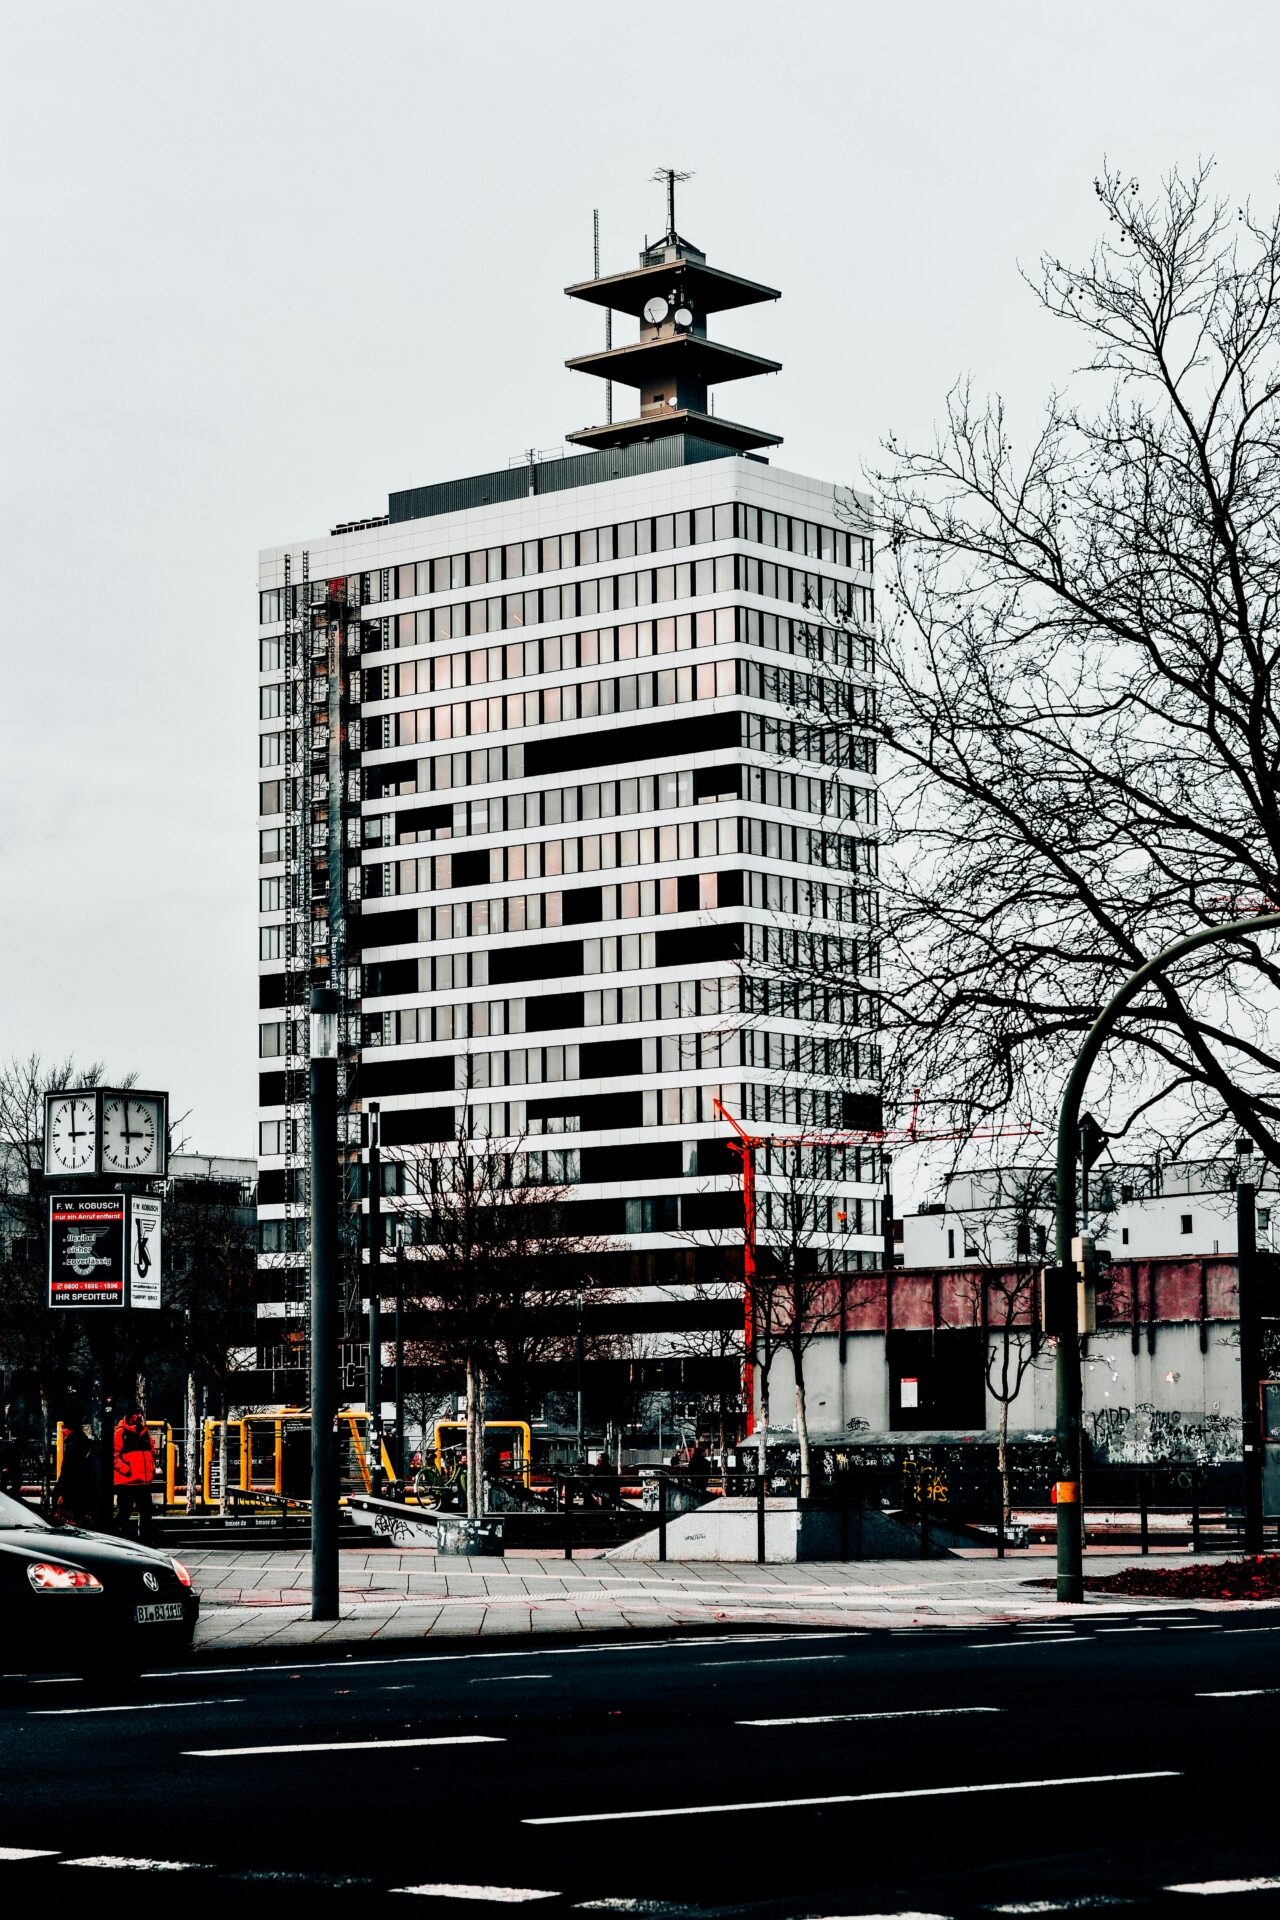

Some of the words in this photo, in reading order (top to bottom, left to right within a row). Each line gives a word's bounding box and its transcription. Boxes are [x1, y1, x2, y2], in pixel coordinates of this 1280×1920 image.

[331, 968, 338, 980] im
[79, 1202, 120, 1210] KOBUSCH
[66, 1233, 97, 1242] flexibel
[66, 1245, 93, 1254] sicher
[55, 1293, 70, 1301] IHR
[71, 1292, 118, 1301] SPEDITEUR
